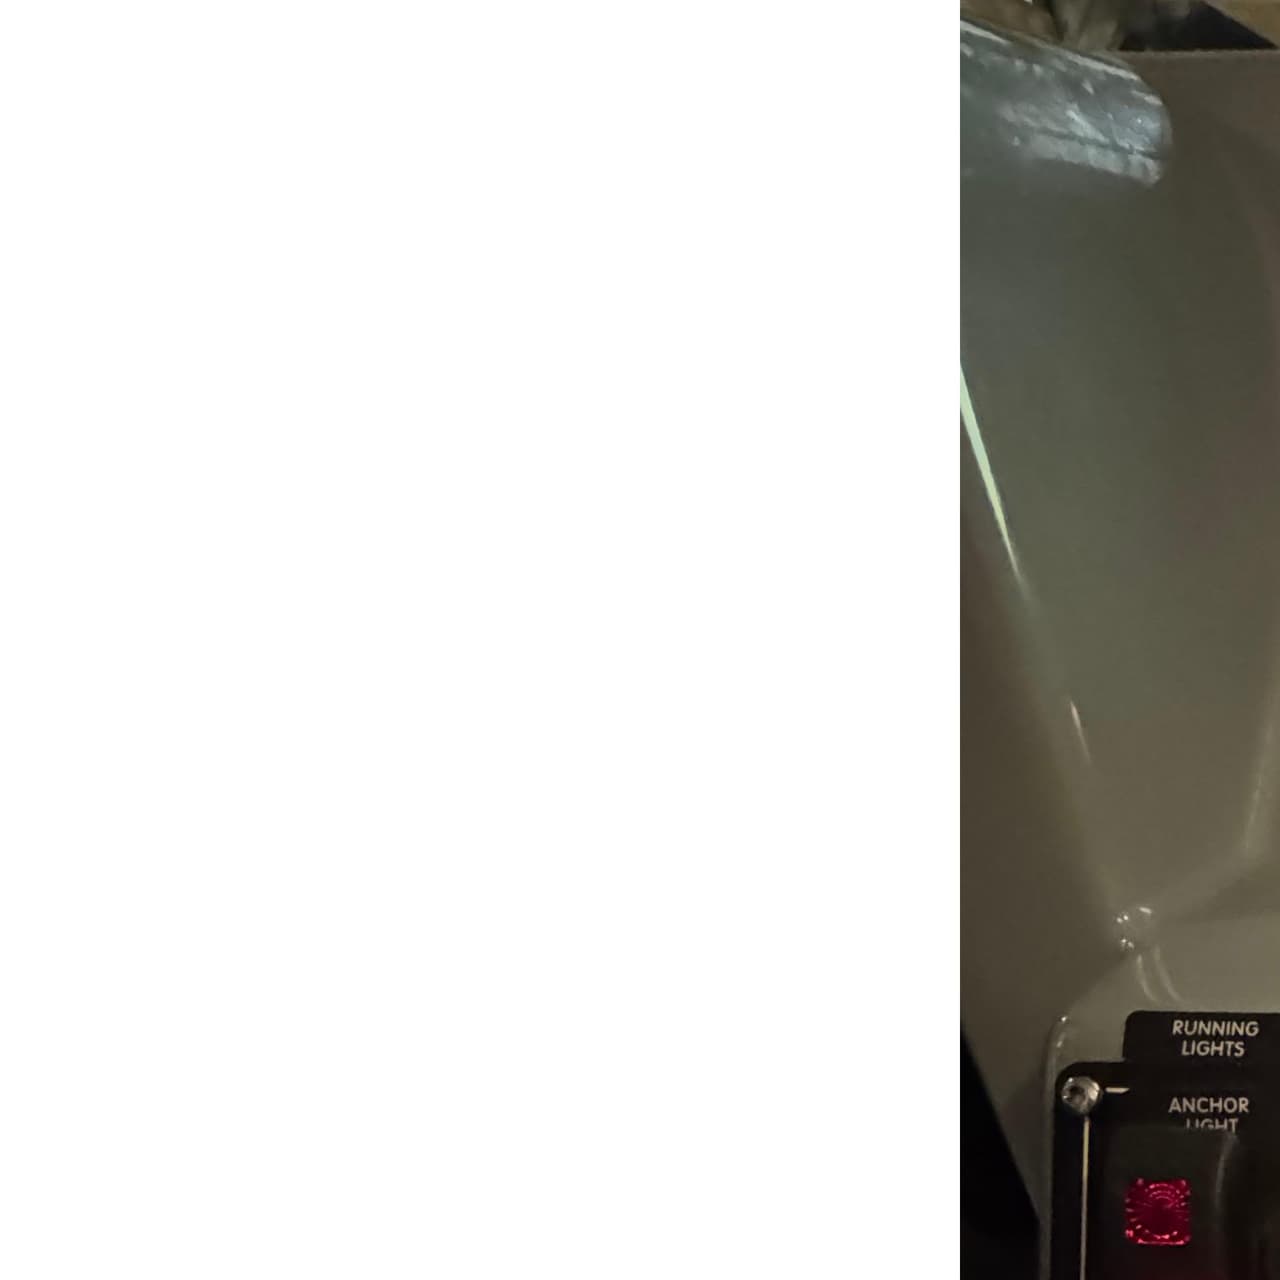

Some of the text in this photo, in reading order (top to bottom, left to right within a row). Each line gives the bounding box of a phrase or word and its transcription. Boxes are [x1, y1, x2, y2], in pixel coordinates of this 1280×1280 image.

[1172, 1019, 1259, 1036] RUNNING
[1181, 1040, 1245, 1057] LIGHTS
[1168, 1097, 1249, 1113] ANCHOR
